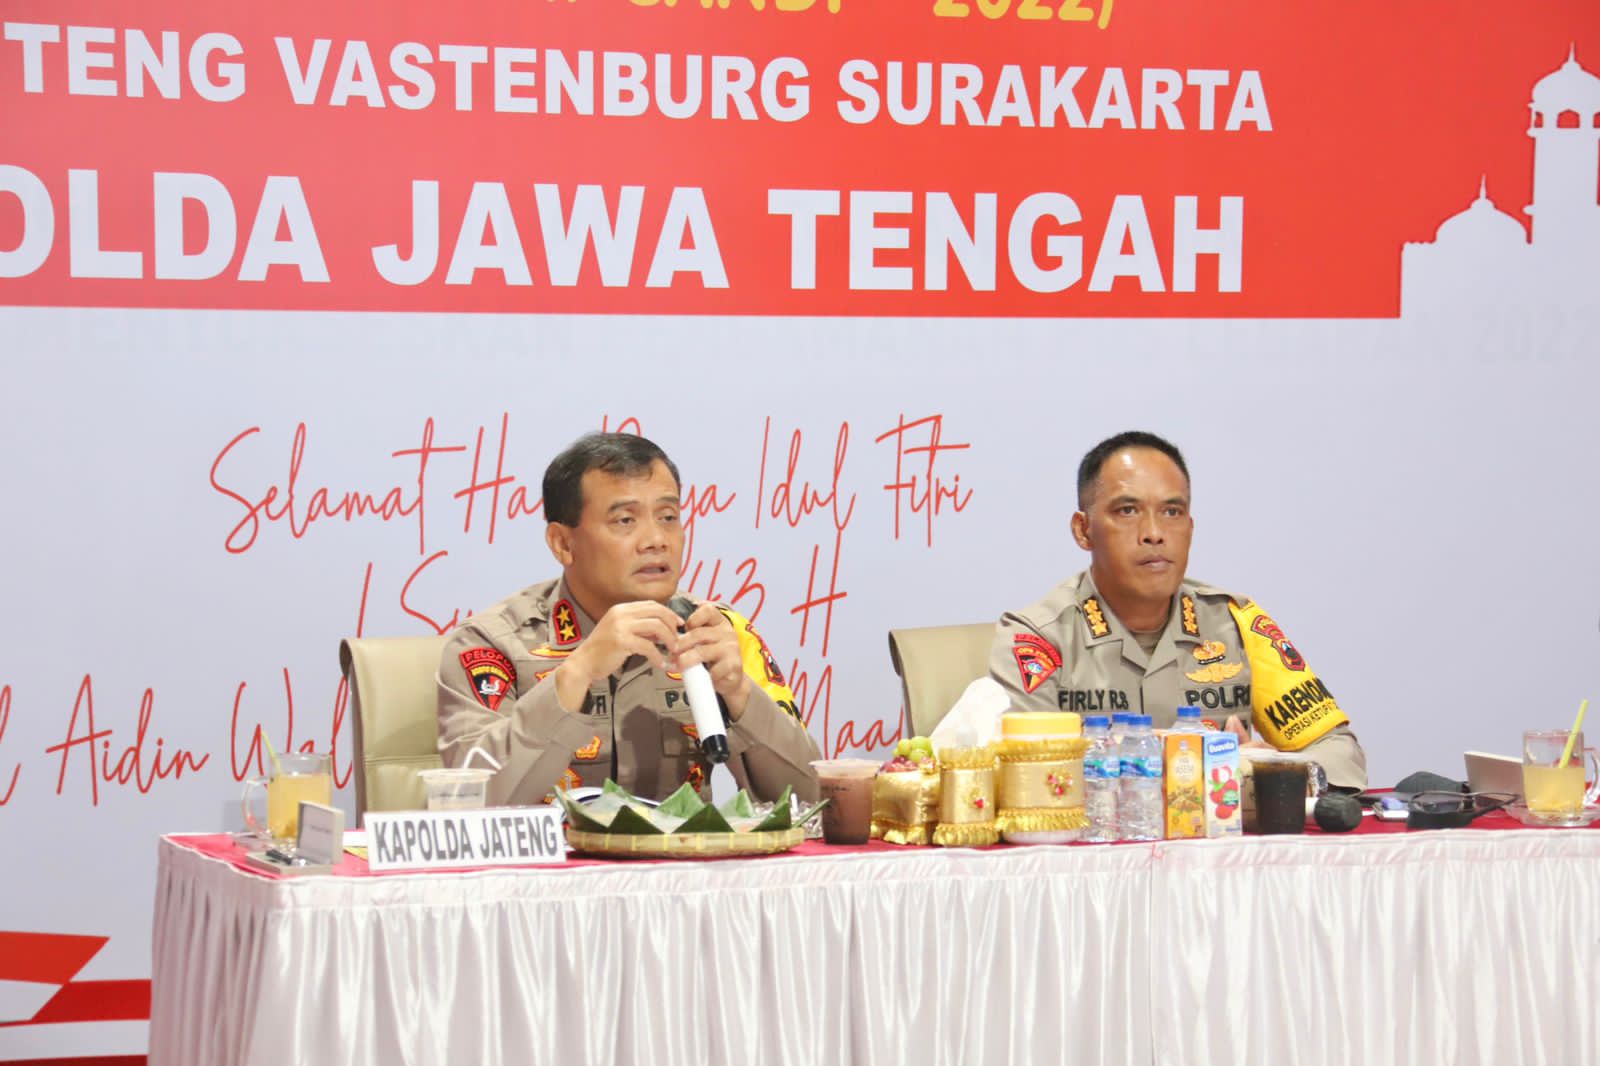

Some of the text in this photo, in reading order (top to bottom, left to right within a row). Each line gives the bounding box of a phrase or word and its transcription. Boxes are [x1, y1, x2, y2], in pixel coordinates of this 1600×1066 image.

[274, 36, 810, 122] VASTENBURG
[837, 59, 1273, 131] SURAKARTA
[371, 179, 730, 289] JAWA
[767, 189, 1244, 293] TENGAH
[209, 416, 466, 554] Selamat
[453, 412, 546, 545] Ha
[755, 416, 857, 530] Idul
[875, 414, 974, 547] Fitri
[46, 673, 210, 806] Aidin
[1057, 689, 1105, 711] FIRLY
[374, 815, 558, 863] KAPOLDA JATENG
